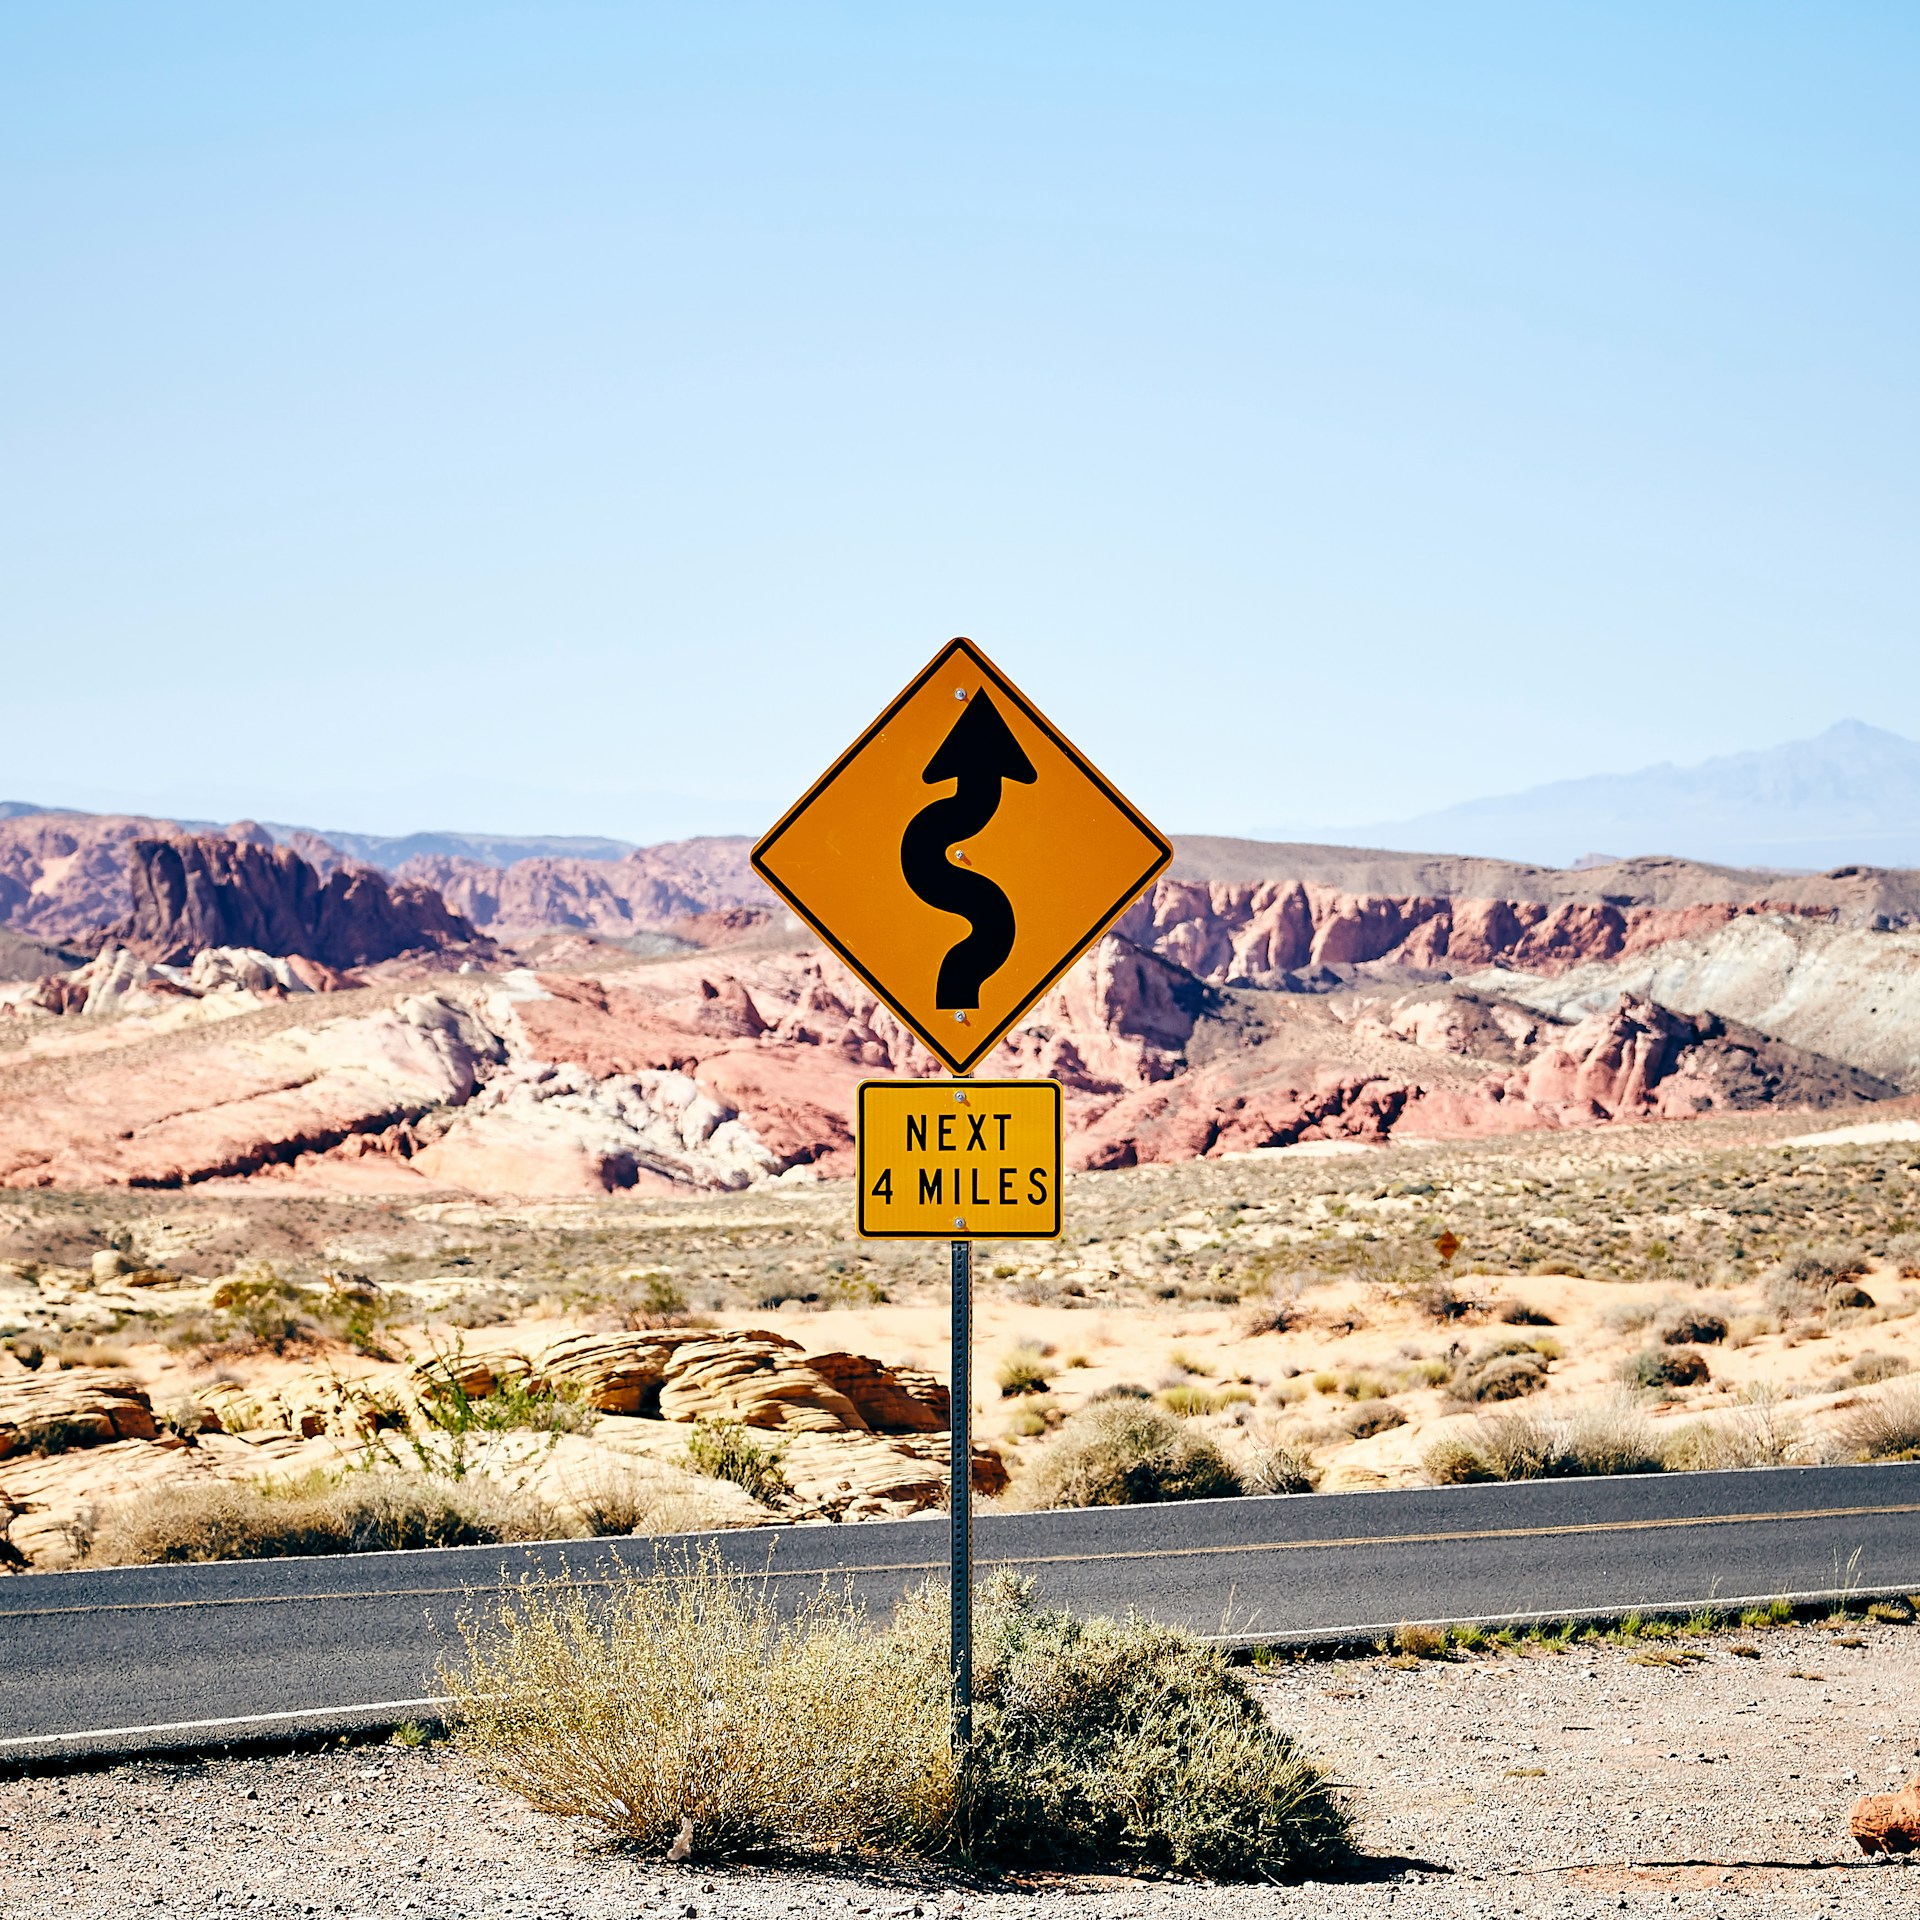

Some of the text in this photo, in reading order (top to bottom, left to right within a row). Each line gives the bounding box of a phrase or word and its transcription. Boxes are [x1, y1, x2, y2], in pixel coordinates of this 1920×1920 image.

[906, 1114, 1012, 1152] NEXT
[871, 1167, 1048, 1206] 4 MILES
